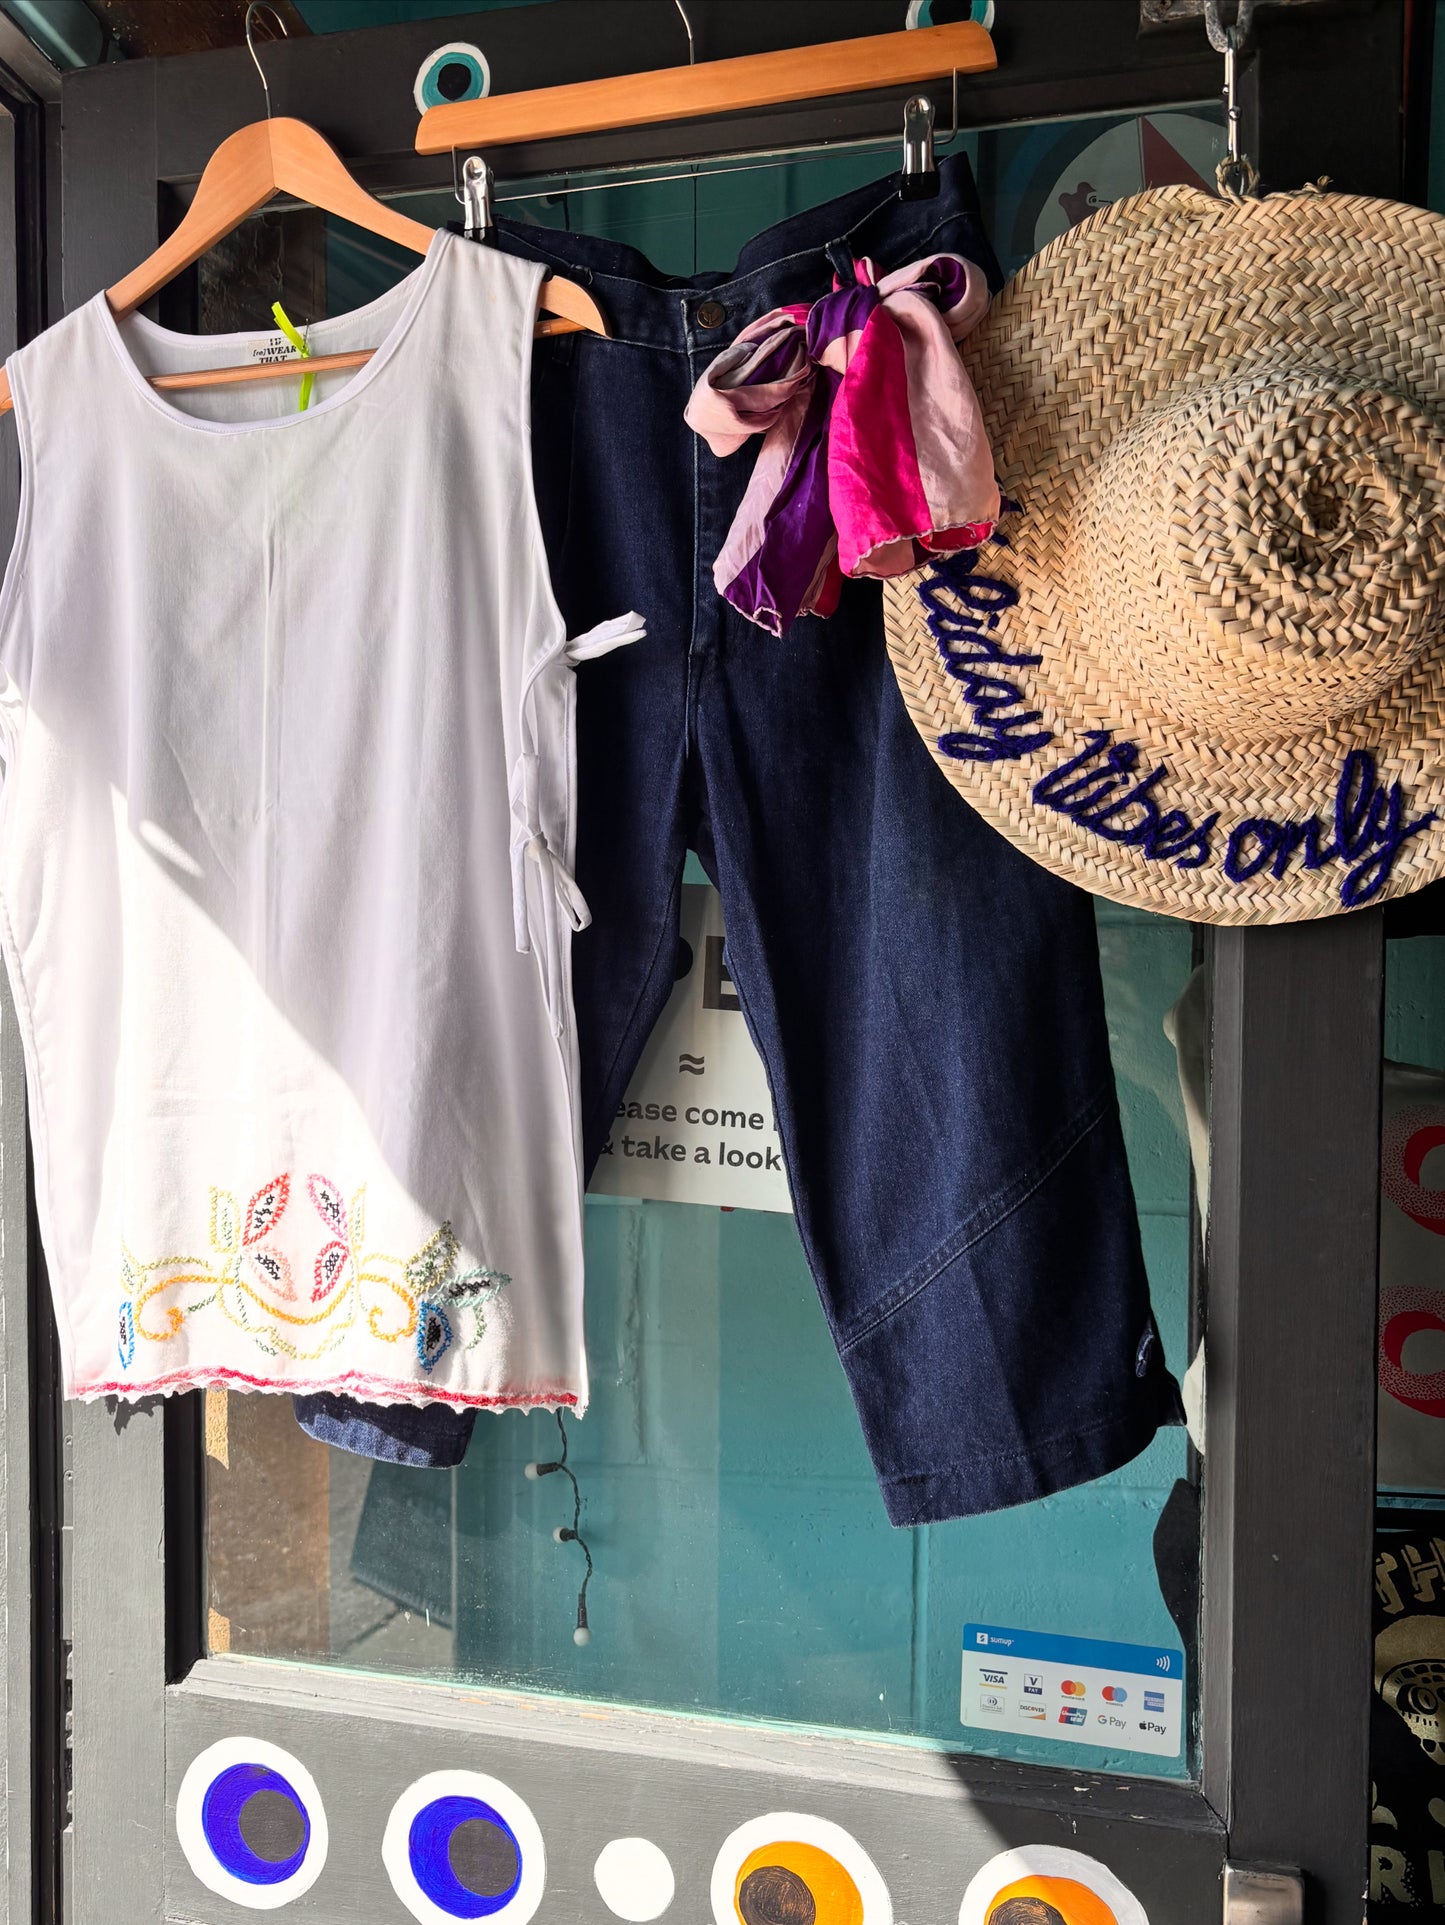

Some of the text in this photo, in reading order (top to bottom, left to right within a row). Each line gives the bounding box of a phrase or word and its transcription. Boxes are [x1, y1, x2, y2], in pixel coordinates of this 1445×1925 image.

[1033, 730, 1220, 869] Vibes
[1224, 749, 1438, 908] only
[615, 1100, 677, 1123] ease
[685, 1105, 764, 1131] come
[621, 1135, 687, 1162] take
[693, 1145, 711, 1165] a
[718, 1142, 782, 1171] look
[983, 1673, 1005, 1684] VISA
[1029, 1676, 1039, 1686] V
[1019, 1704, 1045, 1713] DISCOVER
[1097, 1714, 1107, 1725] G
[1109, 1717, 1126, 1730] Pay
[1147, 1721, 1167, 1735] Pay
